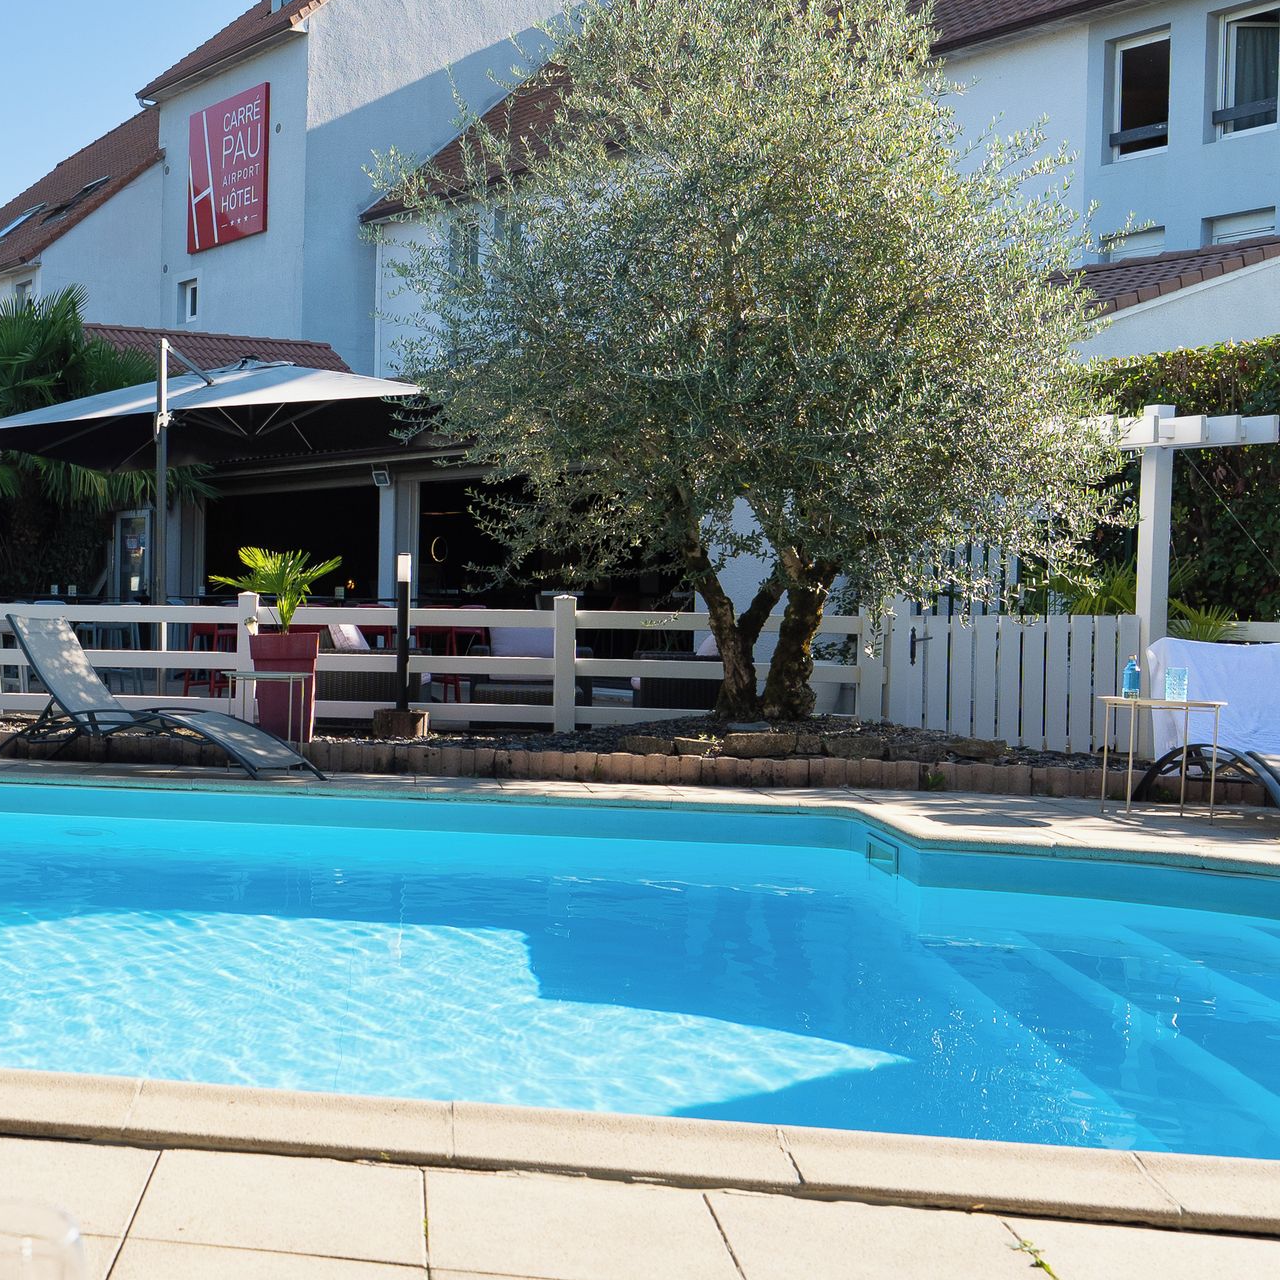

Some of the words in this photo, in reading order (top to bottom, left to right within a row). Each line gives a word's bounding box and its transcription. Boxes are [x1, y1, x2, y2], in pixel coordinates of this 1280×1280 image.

[223, 96, 261, 132] CARRÉ
[222, 123, 261, 169] PAU
[222, 163, 260, 188] AIRPORT
[221, 185, 259, 213] HÔTEL
